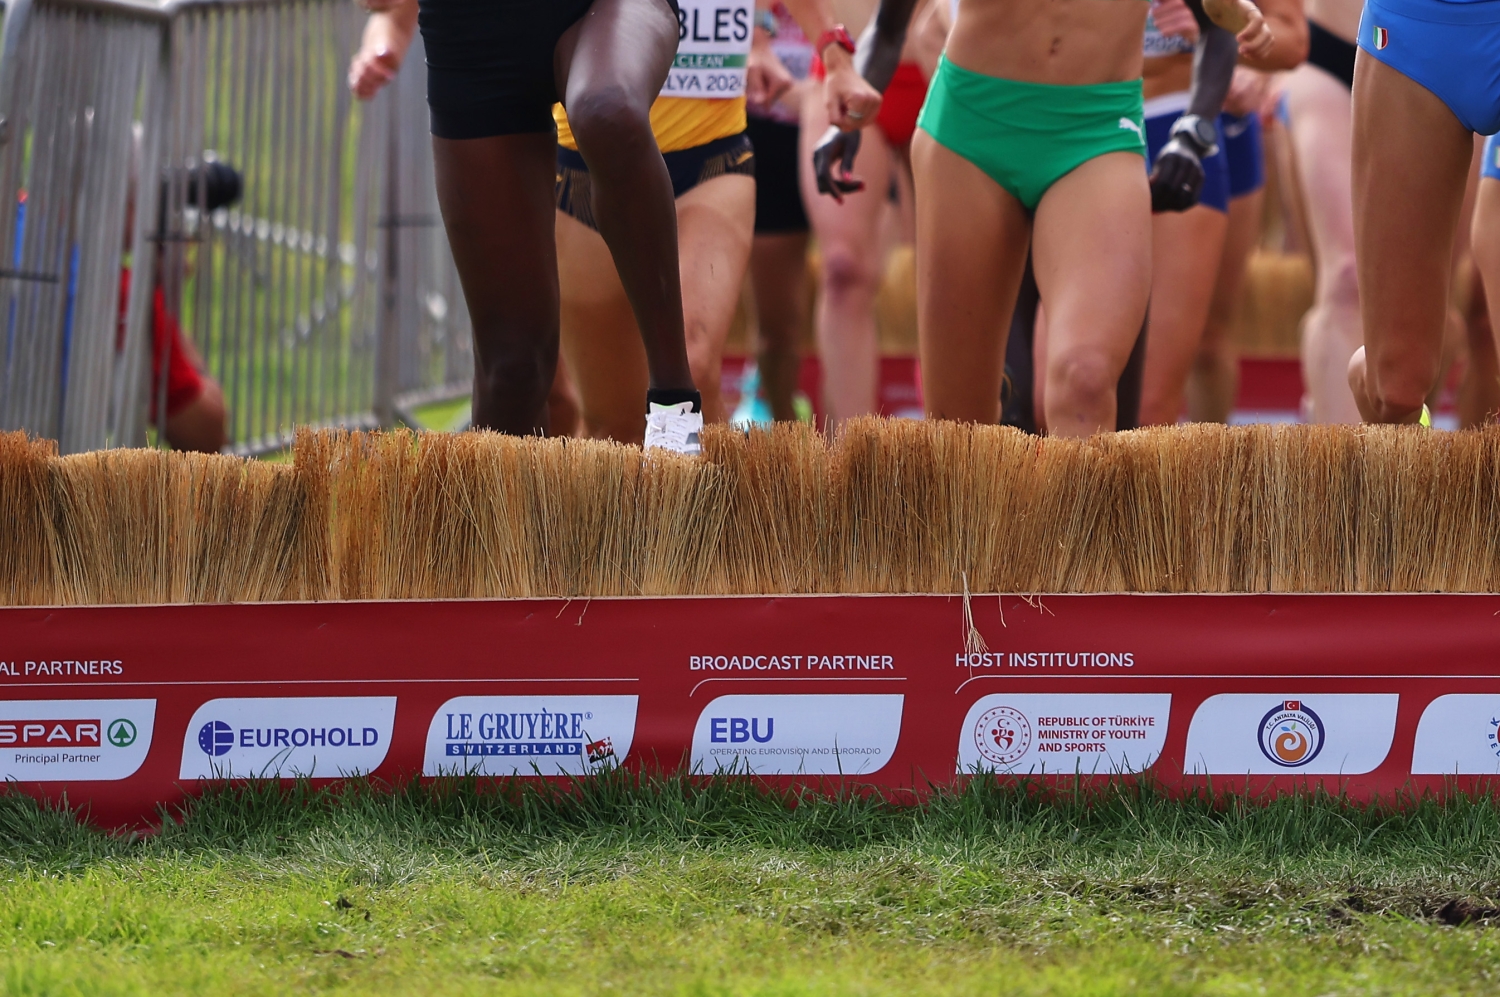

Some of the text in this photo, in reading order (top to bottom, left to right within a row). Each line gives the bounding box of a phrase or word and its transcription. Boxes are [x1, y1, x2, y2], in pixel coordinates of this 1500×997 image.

[24, 660, 124, 676] PARTNERS
[689, 655, 895, 671] BROADCAST PARTNER
[955, 652, 1135, 668] HOST INSTITUTIONS
[445, 712, 473, 740] LE
[1037, 714, 1155, 727] REPUBLIC OF TÜRKİYE
[0, 723, 99, 744] SPAR
[239, 727, 379, 748] EUROHOLD
[710, 717, 774, 744] EBU
[1037, 729, 1147, 740] MINISTRY OF YOUTH
[451, 744, 577, 755] SWITZERLAND
[709, 747, 881, 756] OPERATING EUROVISION AND EURORADIO
[1037, 742, 1106, 753] AND SPORTS
[15, 753, 101, 766] Principal Partner
